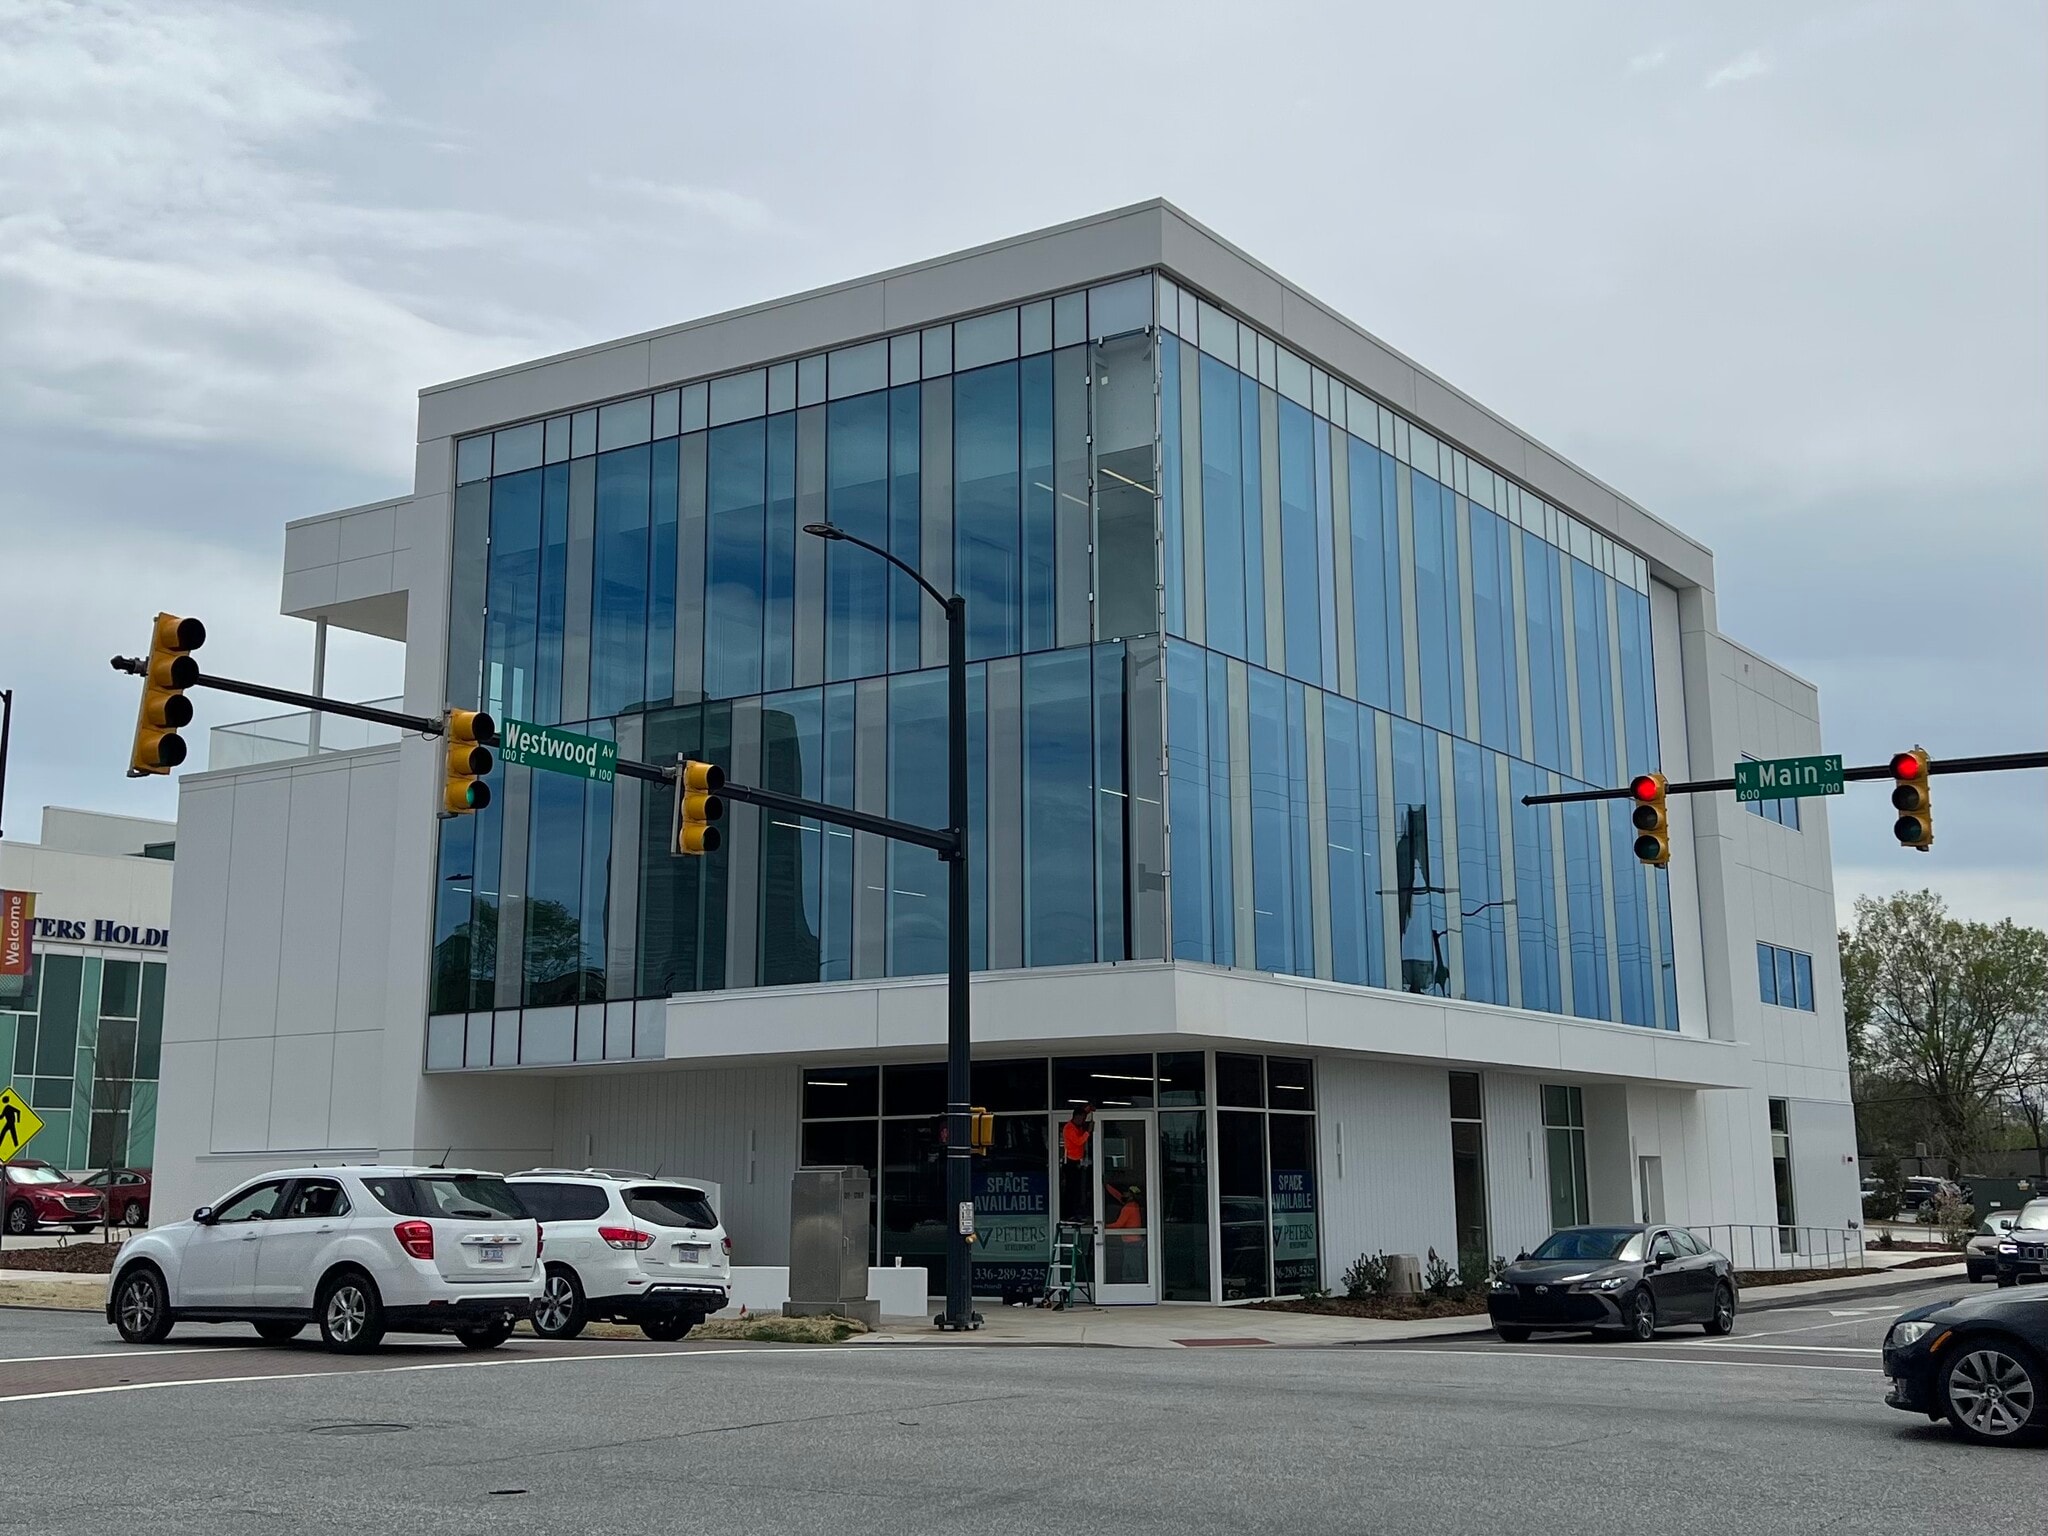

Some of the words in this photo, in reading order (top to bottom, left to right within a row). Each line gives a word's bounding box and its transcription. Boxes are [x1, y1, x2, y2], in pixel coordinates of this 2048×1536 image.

[505, 722, 598, 767] Westwood
[602, 745, 614, 758] Av
[502, 749, 517, 761] 100
[520, 752, 526, 763] E
[589, 767, 596, 778] W
[599, 769, 612, 781] 100
[1738, 772, 1747, 784] N
[1759, 762, 1818, 788] Main
[1824, 759, 1839, 772] St
[1740, 789, 1760, 800] 600
[1819, 783, 1840, 794] 700
[5, 896, 22, 966] Welcome
[987, 1176, 1029, 1193] SPACE
[1278, 1174, 1303, 1191] SPACE
[974, 1194, 1044, 1212] AVAILABLE
[1272, 1193, 1312, 1209] AVAILABLE
[995, 1226, 1046, 1242] PETERS
[1284, 1224, 1314, 1241] PETERS
[974, 1267, 1046, 1280] 336-289-2525
